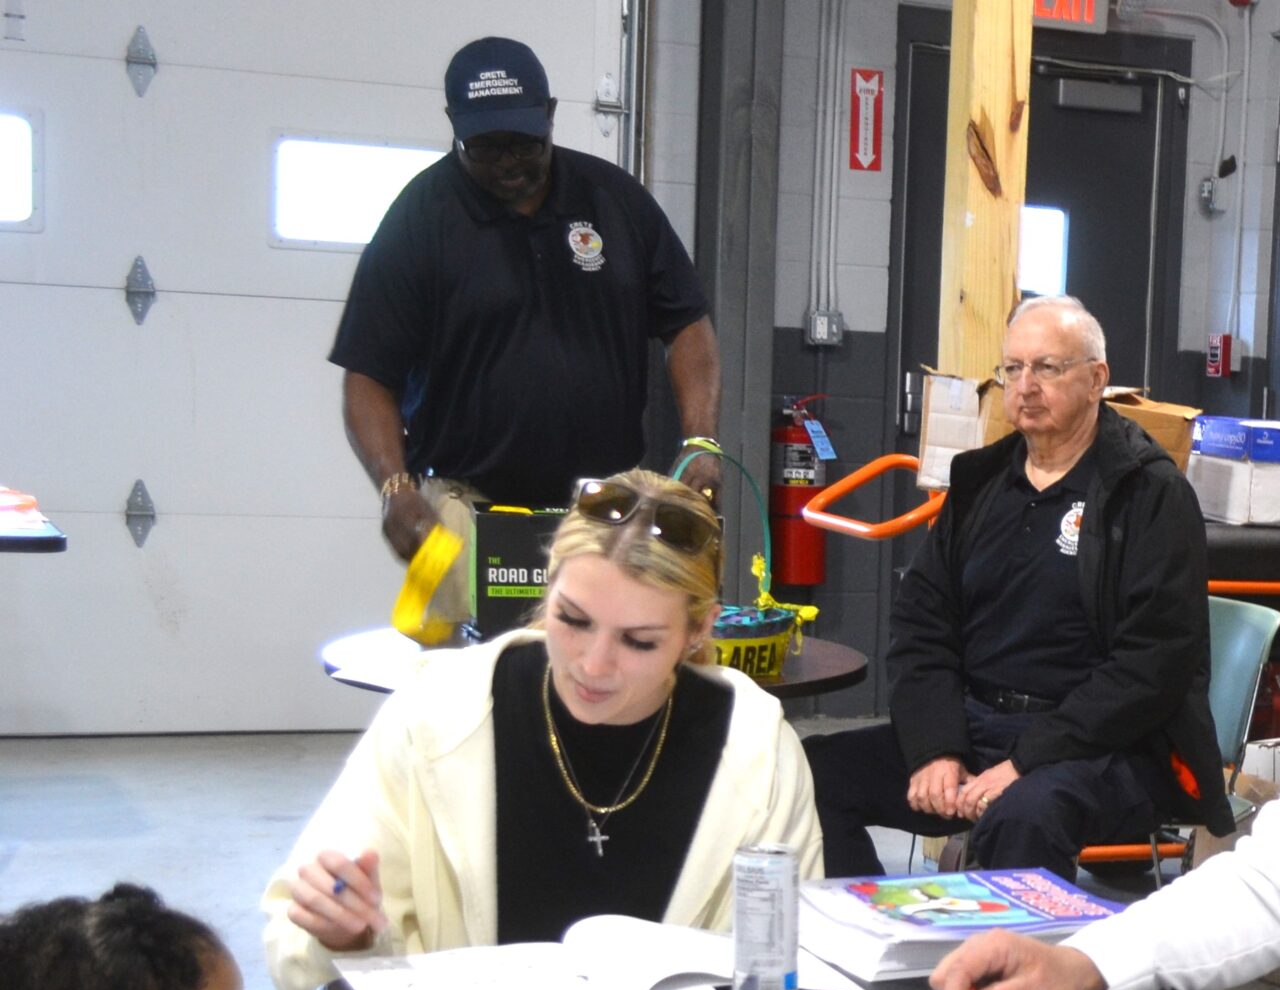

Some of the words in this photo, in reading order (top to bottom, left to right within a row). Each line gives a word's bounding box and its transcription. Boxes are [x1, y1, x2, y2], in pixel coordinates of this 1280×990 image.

[479, 70, 508, 80] CRETE
[469, 79, 519, 90] EMERGENCY
[468, 87, 524, 99] MANAGEMENT
[488, 557, 501, 565] THE
[488, 568, 528, 583] ROAD
[728, 643, 777, 674] AREA
